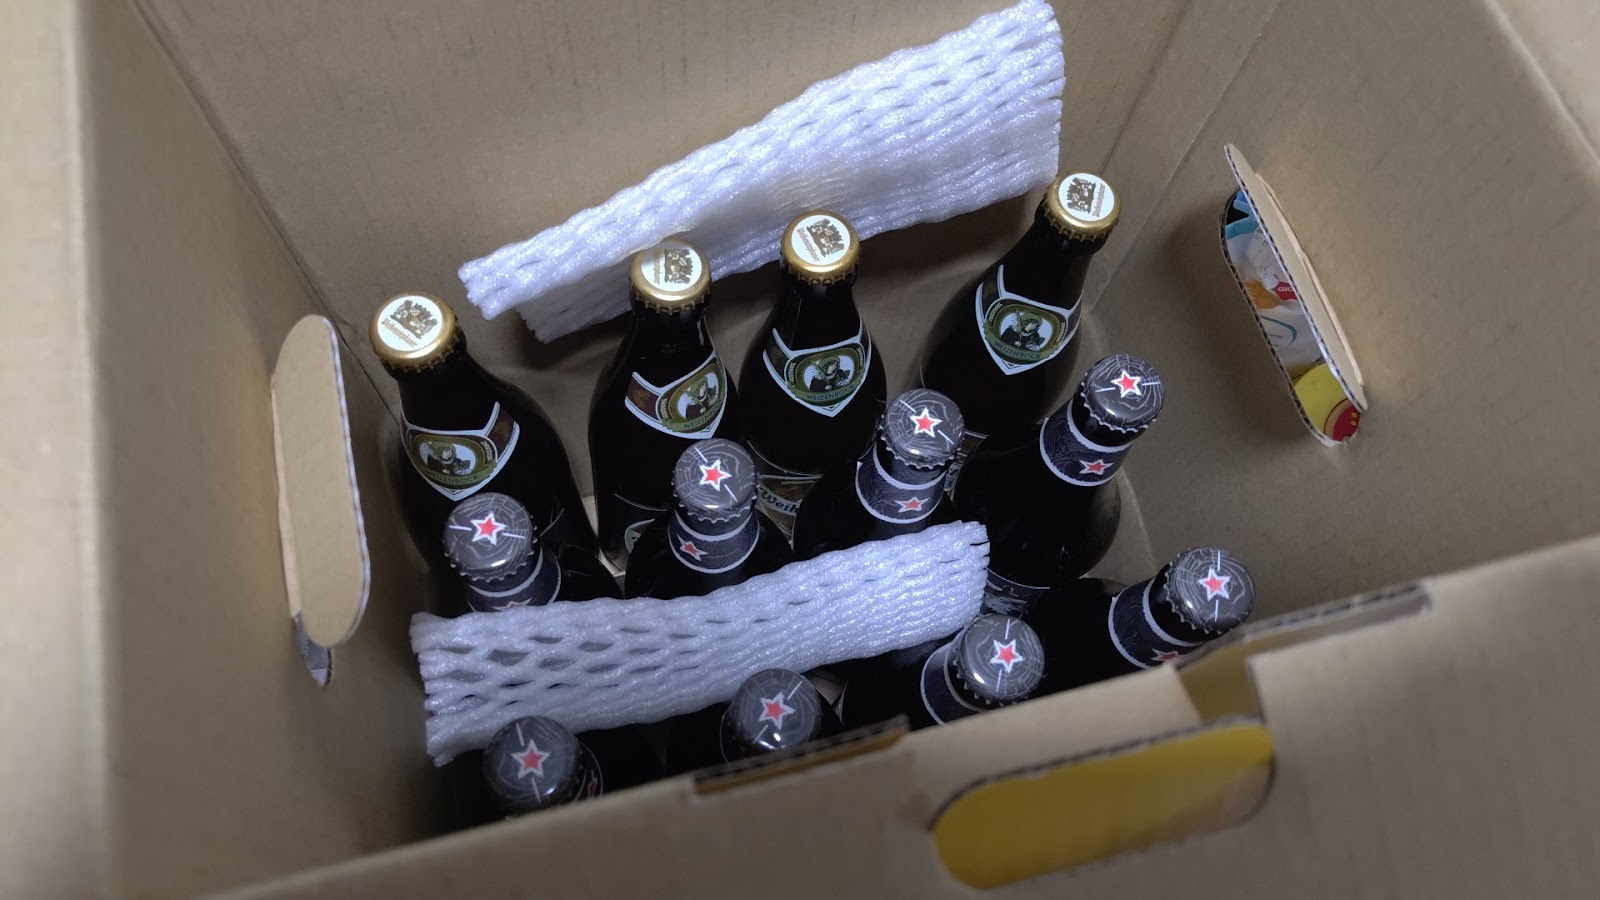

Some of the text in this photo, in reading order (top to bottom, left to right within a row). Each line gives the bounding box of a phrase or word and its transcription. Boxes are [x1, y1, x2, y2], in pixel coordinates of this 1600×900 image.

[381, 317, 418, 347] Weihenstephaner
[994, 340, 1041, 360] WEIZENBOCK
[806, 385, 855, 400] WEIZENBOCK
[427, 471, 480, 484] WEIZENBOCK
